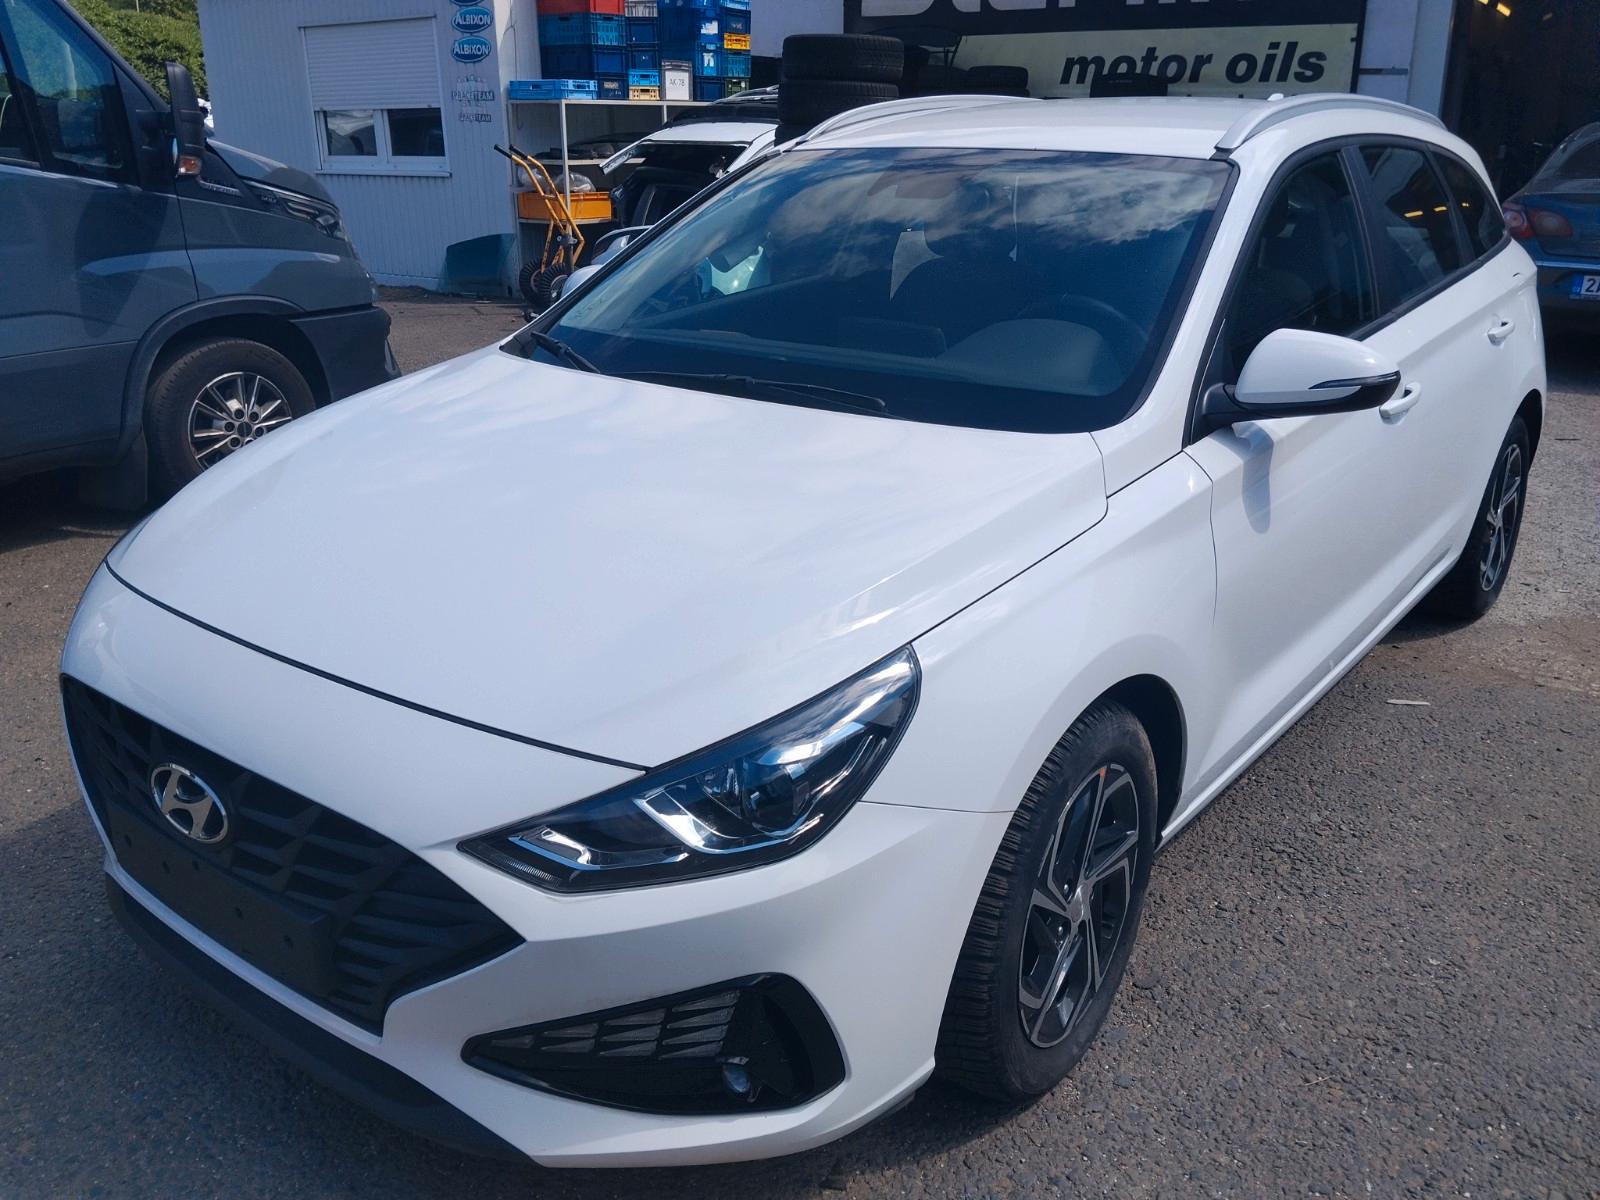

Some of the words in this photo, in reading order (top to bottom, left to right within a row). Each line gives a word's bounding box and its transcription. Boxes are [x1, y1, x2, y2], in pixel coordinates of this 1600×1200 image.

[454, 13, 491, 25] ALBIXON
[453, 44, 490, 55] ALBIXON
[1059, 46, 1214, 85] motor
[1225, 41, 1328, 84] oils
